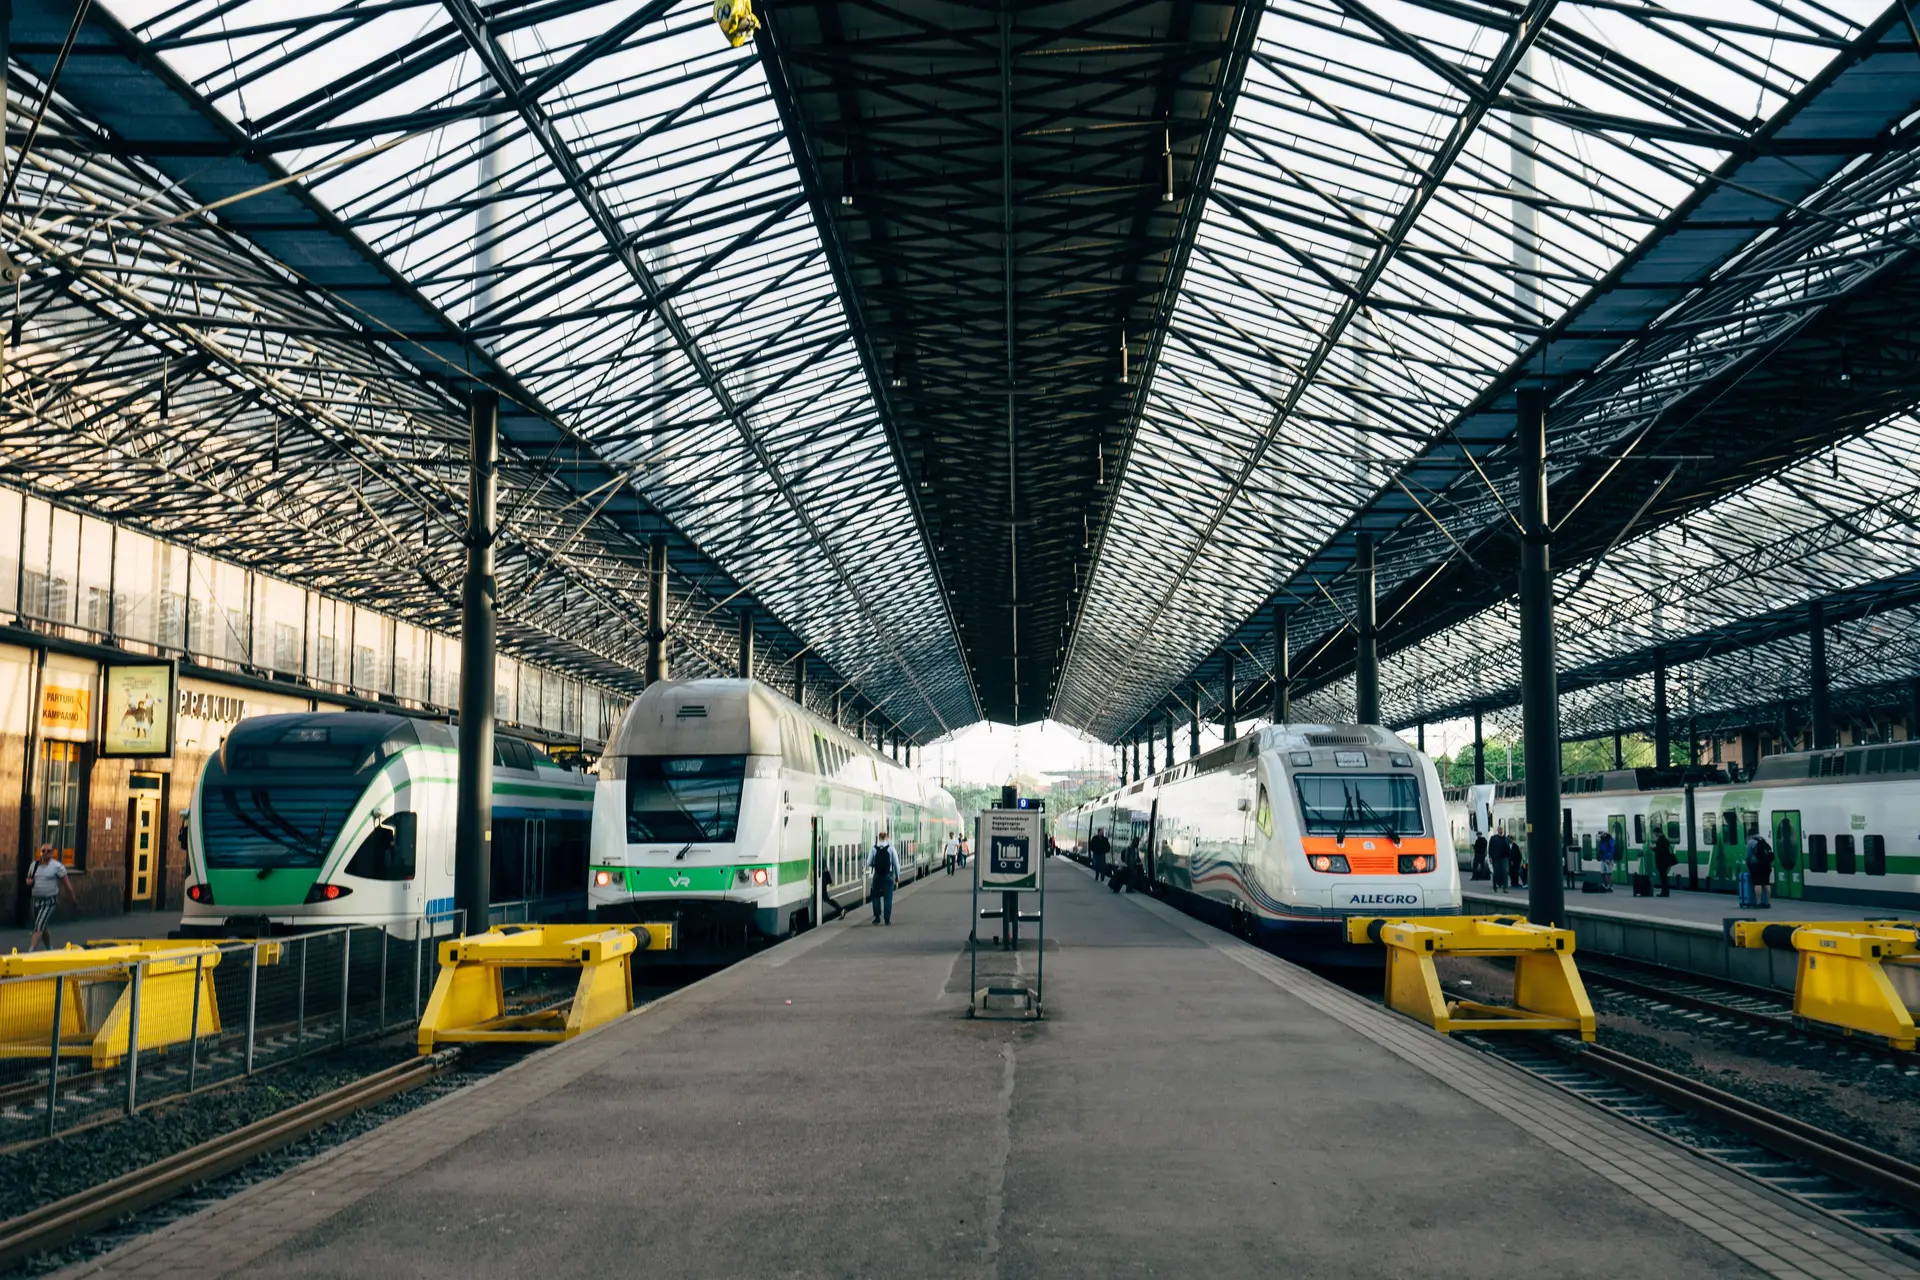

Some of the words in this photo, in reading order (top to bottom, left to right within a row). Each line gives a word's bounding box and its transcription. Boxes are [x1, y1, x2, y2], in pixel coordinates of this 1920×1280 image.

[42, 708, 79, 722] KAMPAAMO
[1020, 799, 1026, 808] 9
[668, 876, 690, 888] VR
[1349, 894, 1417, 905] ALLEGRO
